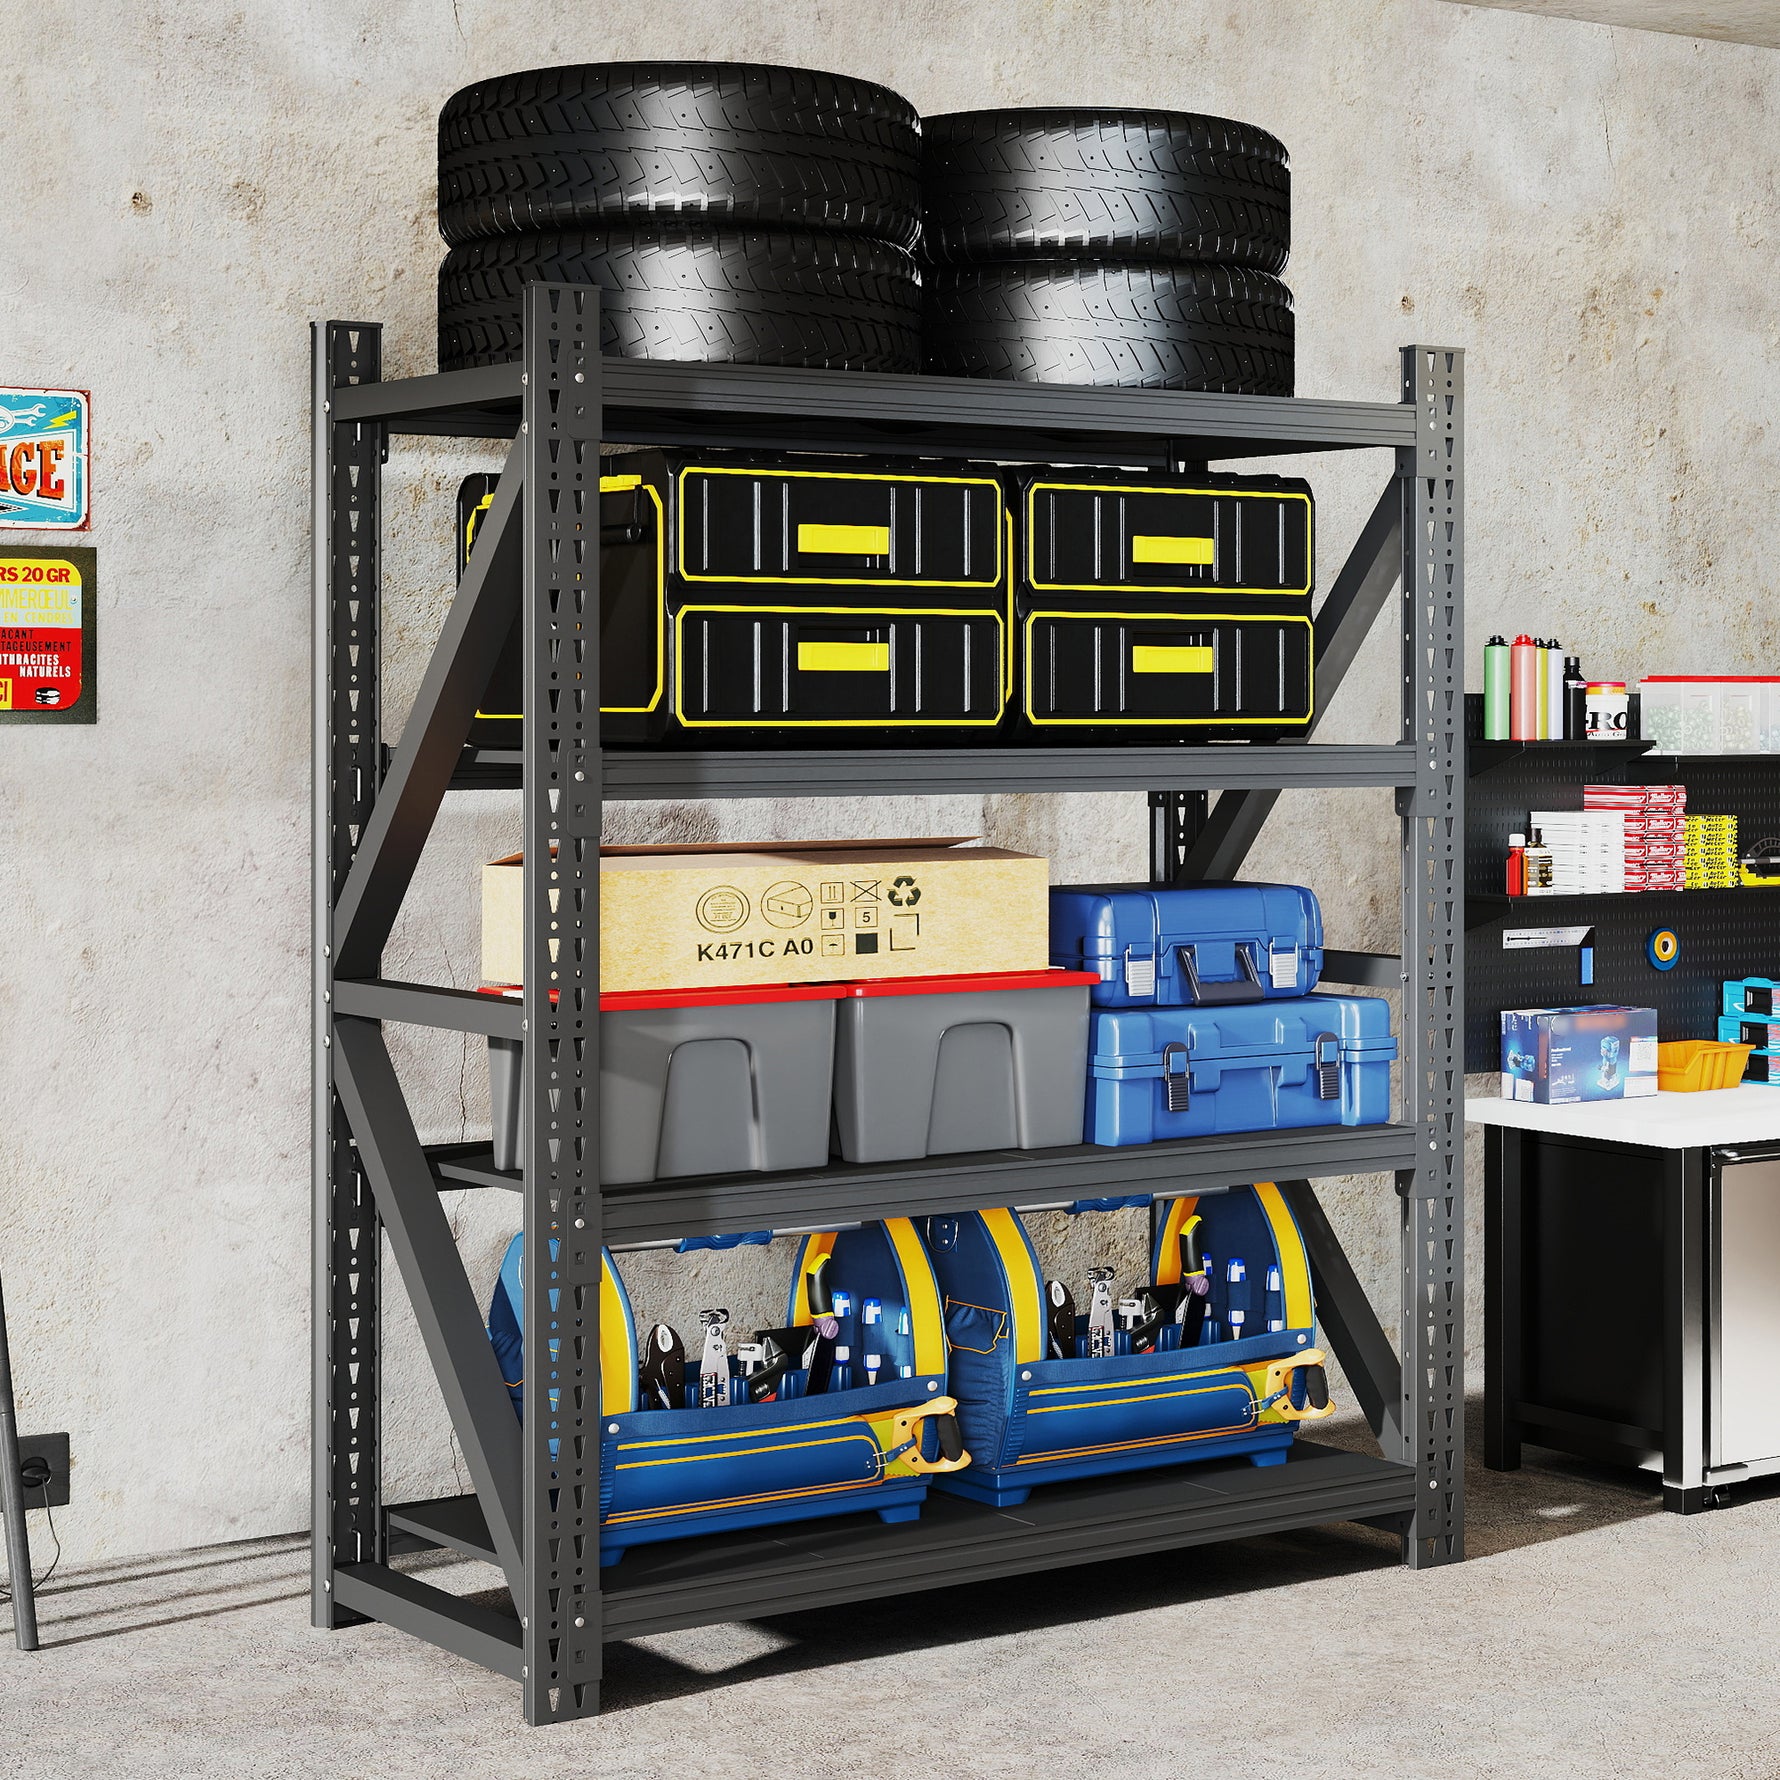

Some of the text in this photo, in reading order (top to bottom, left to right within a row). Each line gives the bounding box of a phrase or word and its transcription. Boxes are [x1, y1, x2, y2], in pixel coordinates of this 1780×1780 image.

[22, 567, 43, 582] 20
[47, 568, 70, 583] GR
[4, 612, 18, 623] EN
[0, 653, 59, 666] THRACITES
[20, 666, 71, 678] NATURELS
[862, 912, 871, 923] 5
[697, 939, 775, 962] K471C
